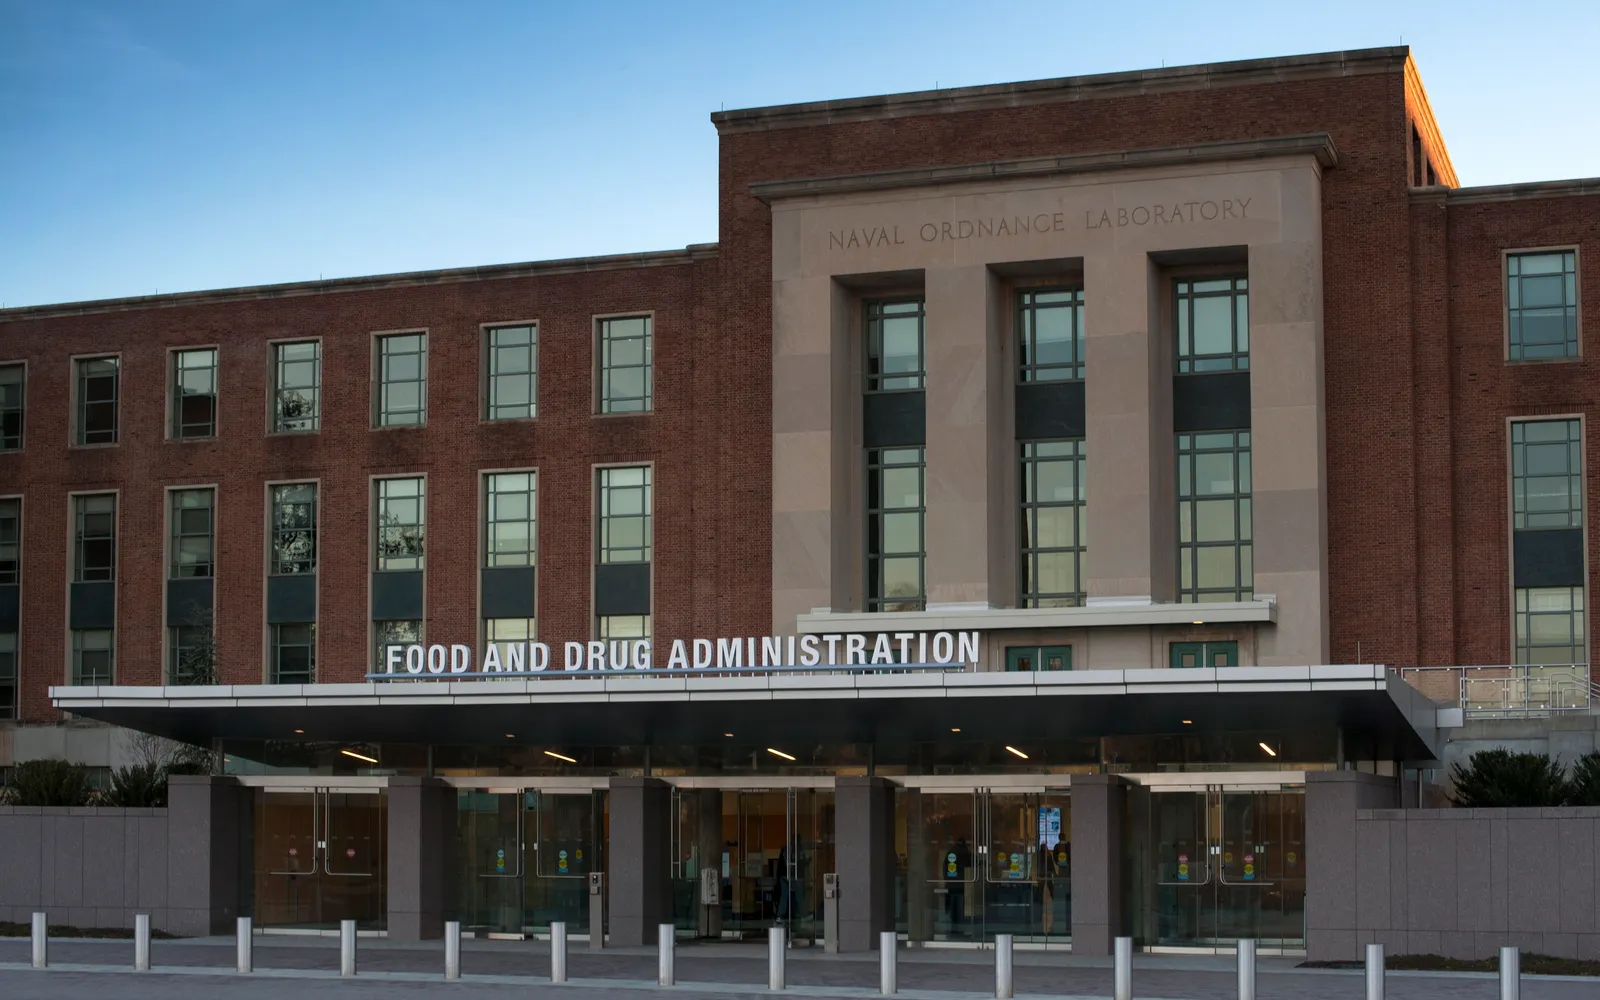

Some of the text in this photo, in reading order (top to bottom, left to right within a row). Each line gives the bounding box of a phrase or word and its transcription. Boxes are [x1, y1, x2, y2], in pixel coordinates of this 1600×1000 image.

[829, 198, 1252, 250] NAVAL ORDNANCE LABORATORY
[386, 631, 979, 674] FOOD AND DRUG ADMINISTRATION
